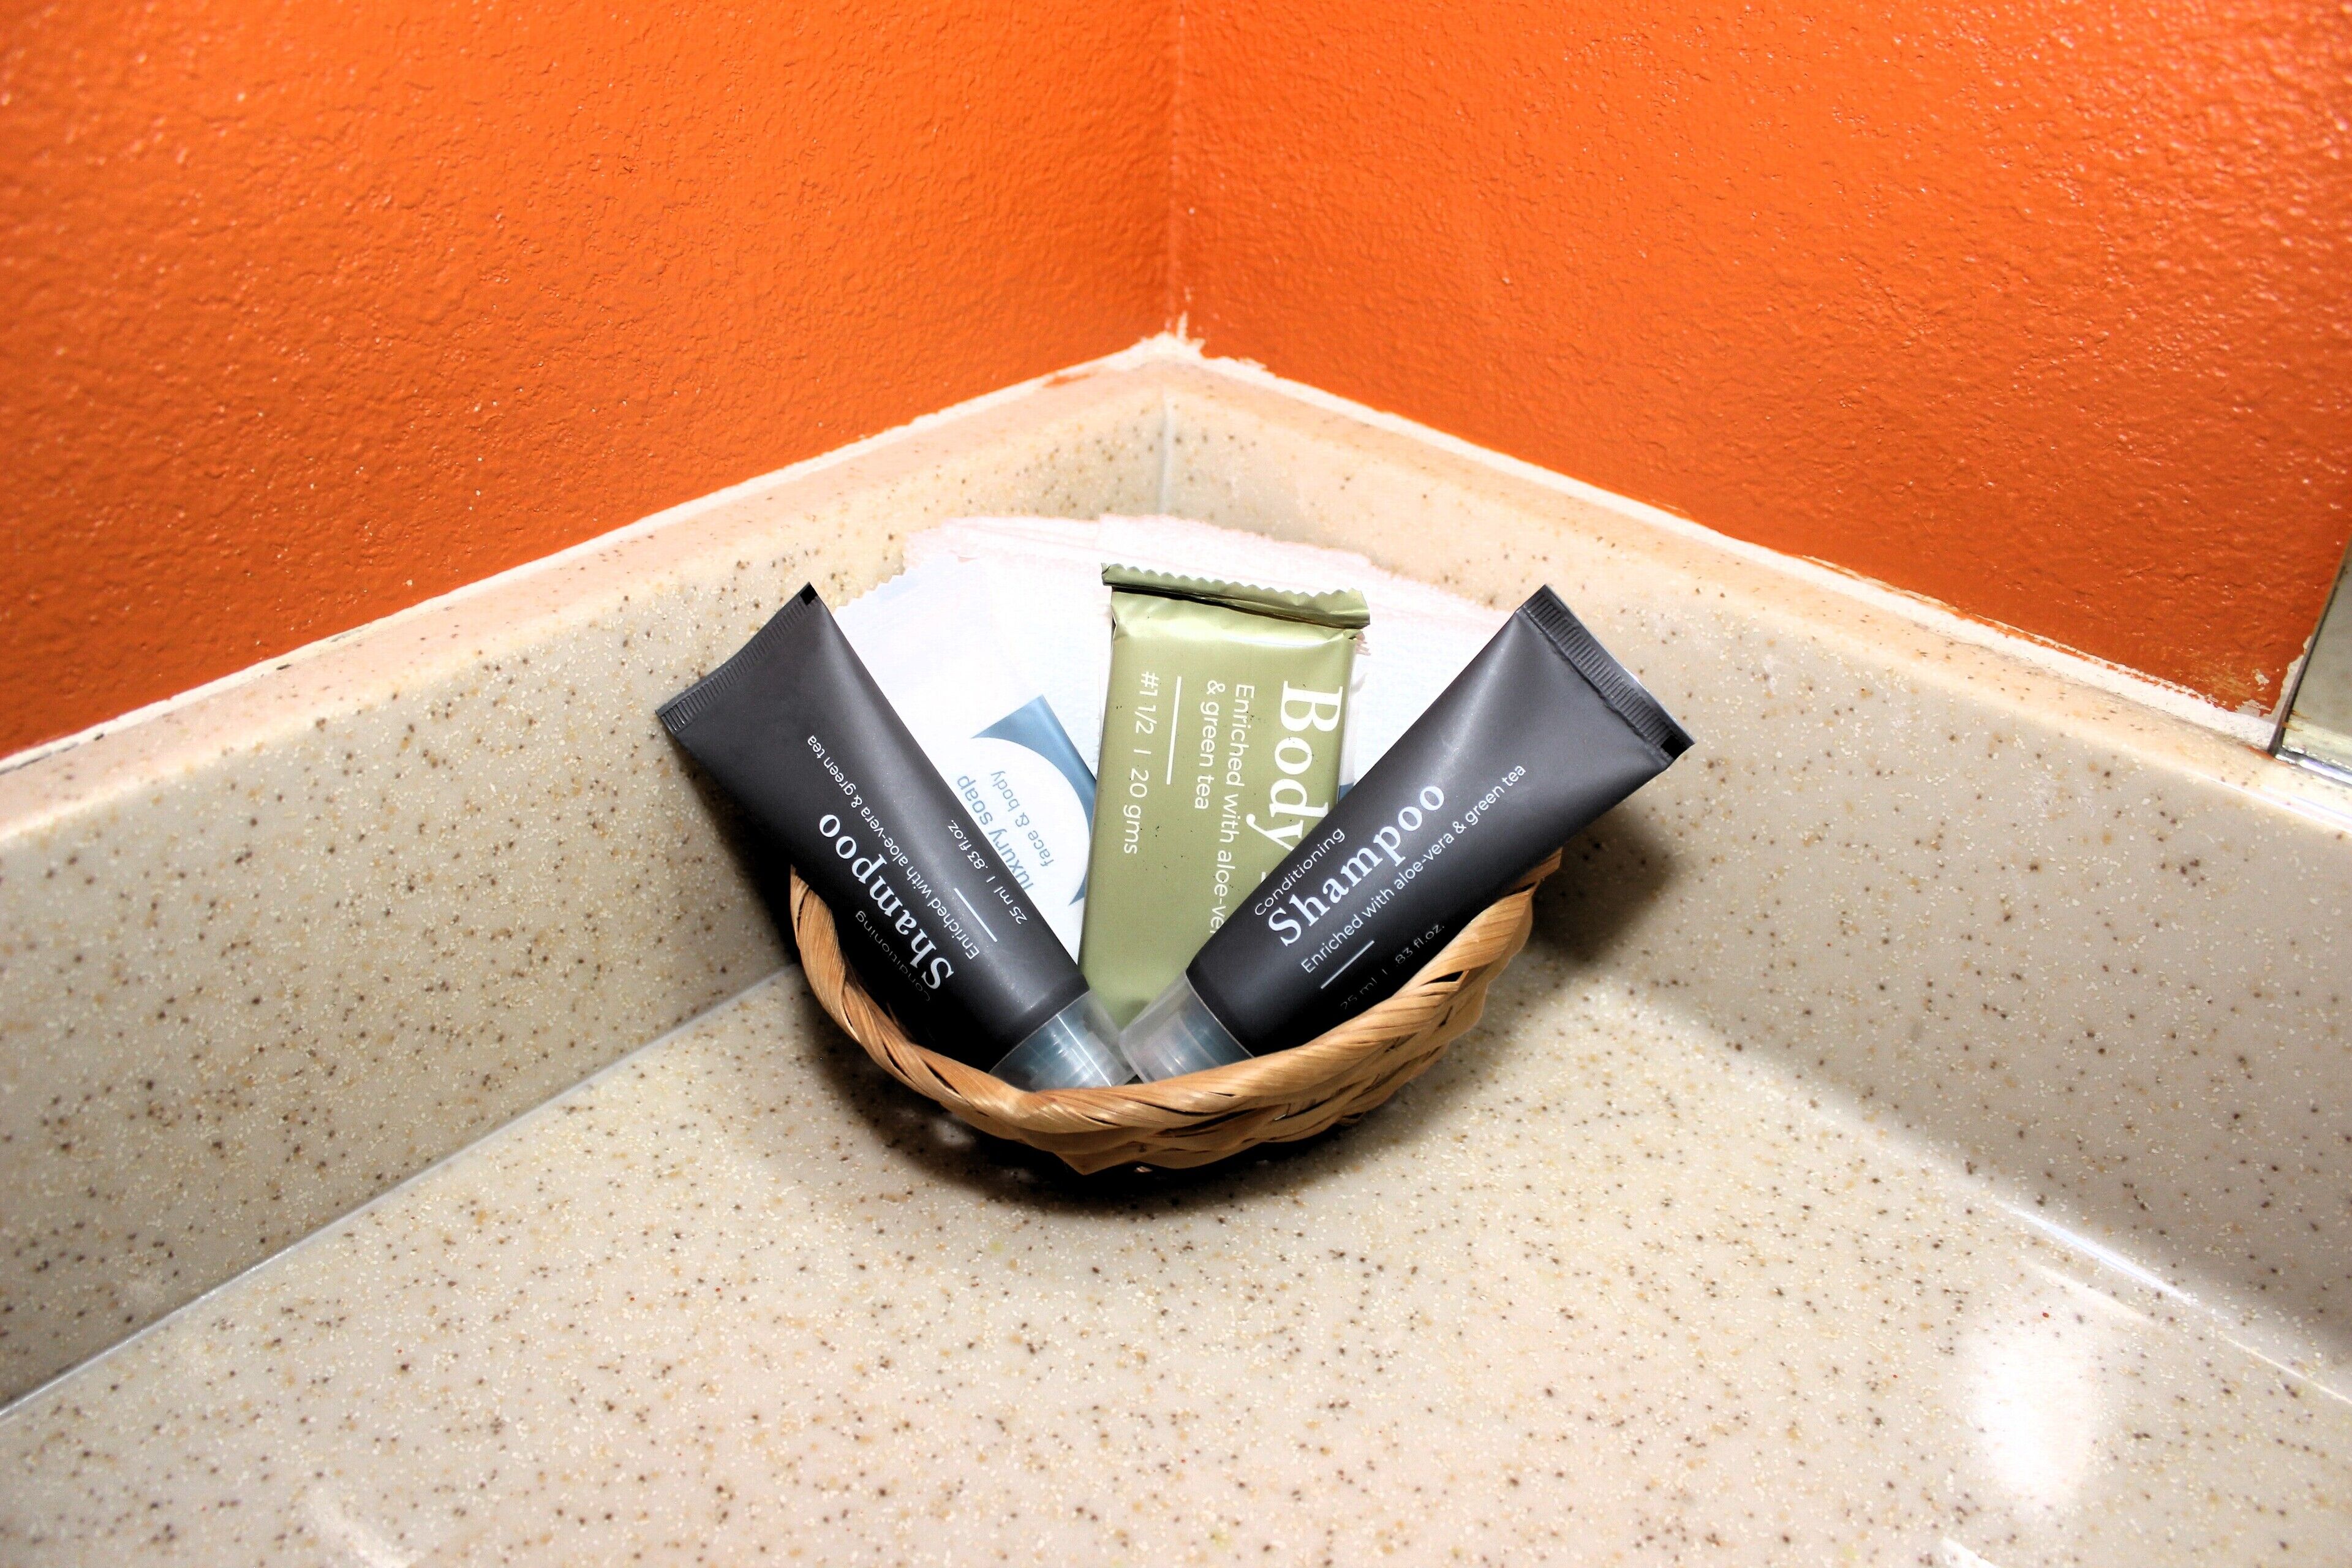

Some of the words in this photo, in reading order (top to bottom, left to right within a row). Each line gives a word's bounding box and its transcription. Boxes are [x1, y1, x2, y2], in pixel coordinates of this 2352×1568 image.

[1139, 671, 1159, 696] #1
[1206, 680, 1226, 695] &
[1135, 705, 1158, 734] 1/2
[1200, 702, 1219, 767] green
[1226, 684, 1255, 787] Enriched
[807, 735, 825, 759] tea
[1246, 680, 1343, 851] Body
[824, 758, 858, 796] green
[990, 771, 1020, 812] body
[1129, 767, 1149, 797] 20
[1194, 775, 1215, 809] tea
[851, 794, 863, 809] &
[957, 775, 993, 826] soap
[1016, 812, 1030, 827] &
[1219, 794, 1241, 843] with
[861, 806, 909, 866] aloe-vera
[948, 820, 972, 850] fl.oz.
[1028, 830, 1054, 867] face
[1123, 804, 1142, 854] gms
[967, 851, 989, 870] .83
[989, 828, 1034, 891] luxury
[1254, 828, 1345, 916] Conditioning
[1268, 786, 1444, 947] Shampoo
[1300, 914, 1363, 973] Enriched
[1361, 888, 1395, 917] with
[1394, 832, 1455, 889] aloe-vera
[1453, 821, 1467, 834] &
[1465, 785, 1505, 826] green
[1501, 765, 1526, 785] tea
[819, 814, 954, 990] Shampoo
[907, 865, 932, 899] with
[993, 886, 1014, 905] ml
[928, 896, 979, 960] Enriched
[1009, 907, 1027, 925] 25
[855, 910, 930, 1001] Conditioning
[1360, 977, 1378, 996] ml
[1413, 923, 1444, 948] fl.oz.
